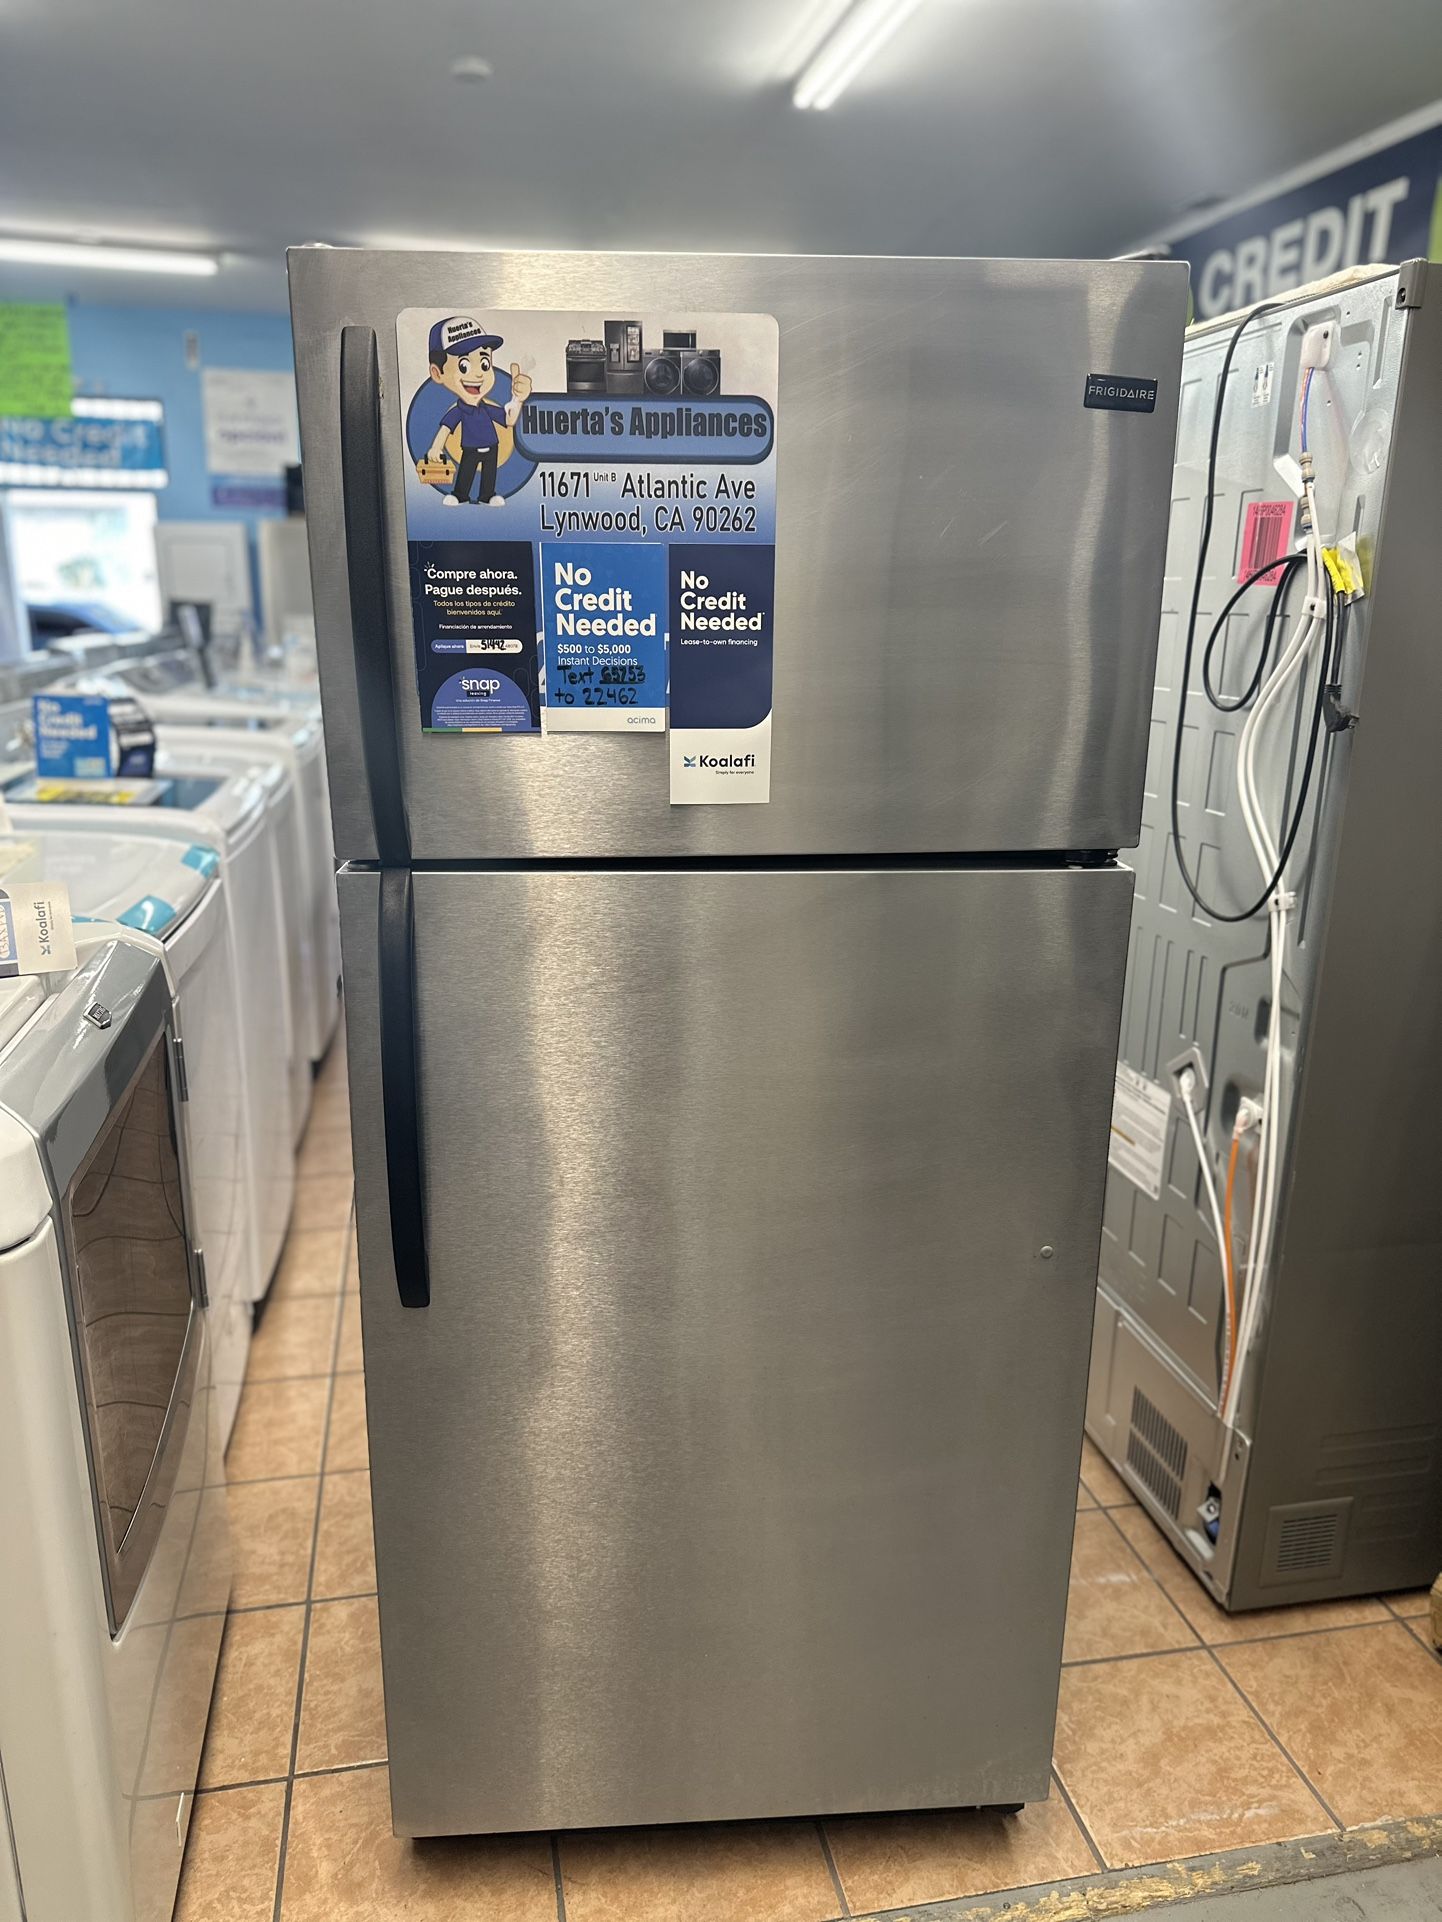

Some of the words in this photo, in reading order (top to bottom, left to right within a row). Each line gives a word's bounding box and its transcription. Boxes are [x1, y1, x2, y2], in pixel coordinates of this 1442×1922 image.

[1200, 176, 1410, 319] CREDIT
[447, 321, 473, 334] Huerta's
[447, 328, 482, 343] Appliances
[1088, 385, 1155, 400] FRIGIDAIRE
[522, 405, 625, 437] Huerta's
[629, 407, 768, 440] Appliances
[539, 471, 591, 499] 11671
[593, 472, 609, 483] Unit
[610, 473, 617, 483] B
[621, 472, 708, 500] Atlantic
[714, 473, 756, 500] Ave
[540, 505, 648, 538] Lynwood,
[655, 506, 687, 532] CA
[692, 506, 757, 533] 90262
[427, 568, 477, 582] Compre
[479, 568, 518, 580] ahora.
[554, 562, 592, 586] No
[680, 570, 709, 590] No
[424, 584, 464, 598] Pague
[466, 584, 523, 598] después.
[554, 587, 633, 611] Credit
[465, 600, 482, 608] tipos
[680, 591, 747, 610] Credit
[556, 613, 657, 637] Needed
[557, 644, 582, 654] $500
[584, 645, 596, 654] to
[597, 644, 631, 655] $5,000
[680, 638, 727, 646] Lease-to-own
[727, 638, 758, 647] financing
[558, 656, 590, 666] Instant
[592, 656, 638, 667] Decisions
[557, 665, 594, 685] Text
[461, 679, 501, 695] snap
[554, 688, 575, 705] to
[582, 687, 639, 706] 22462
[627, 716, 656, 725] acima
[699, 754, 755, 768] Koalafi
[33, 901, 50, 943] Koalafi
